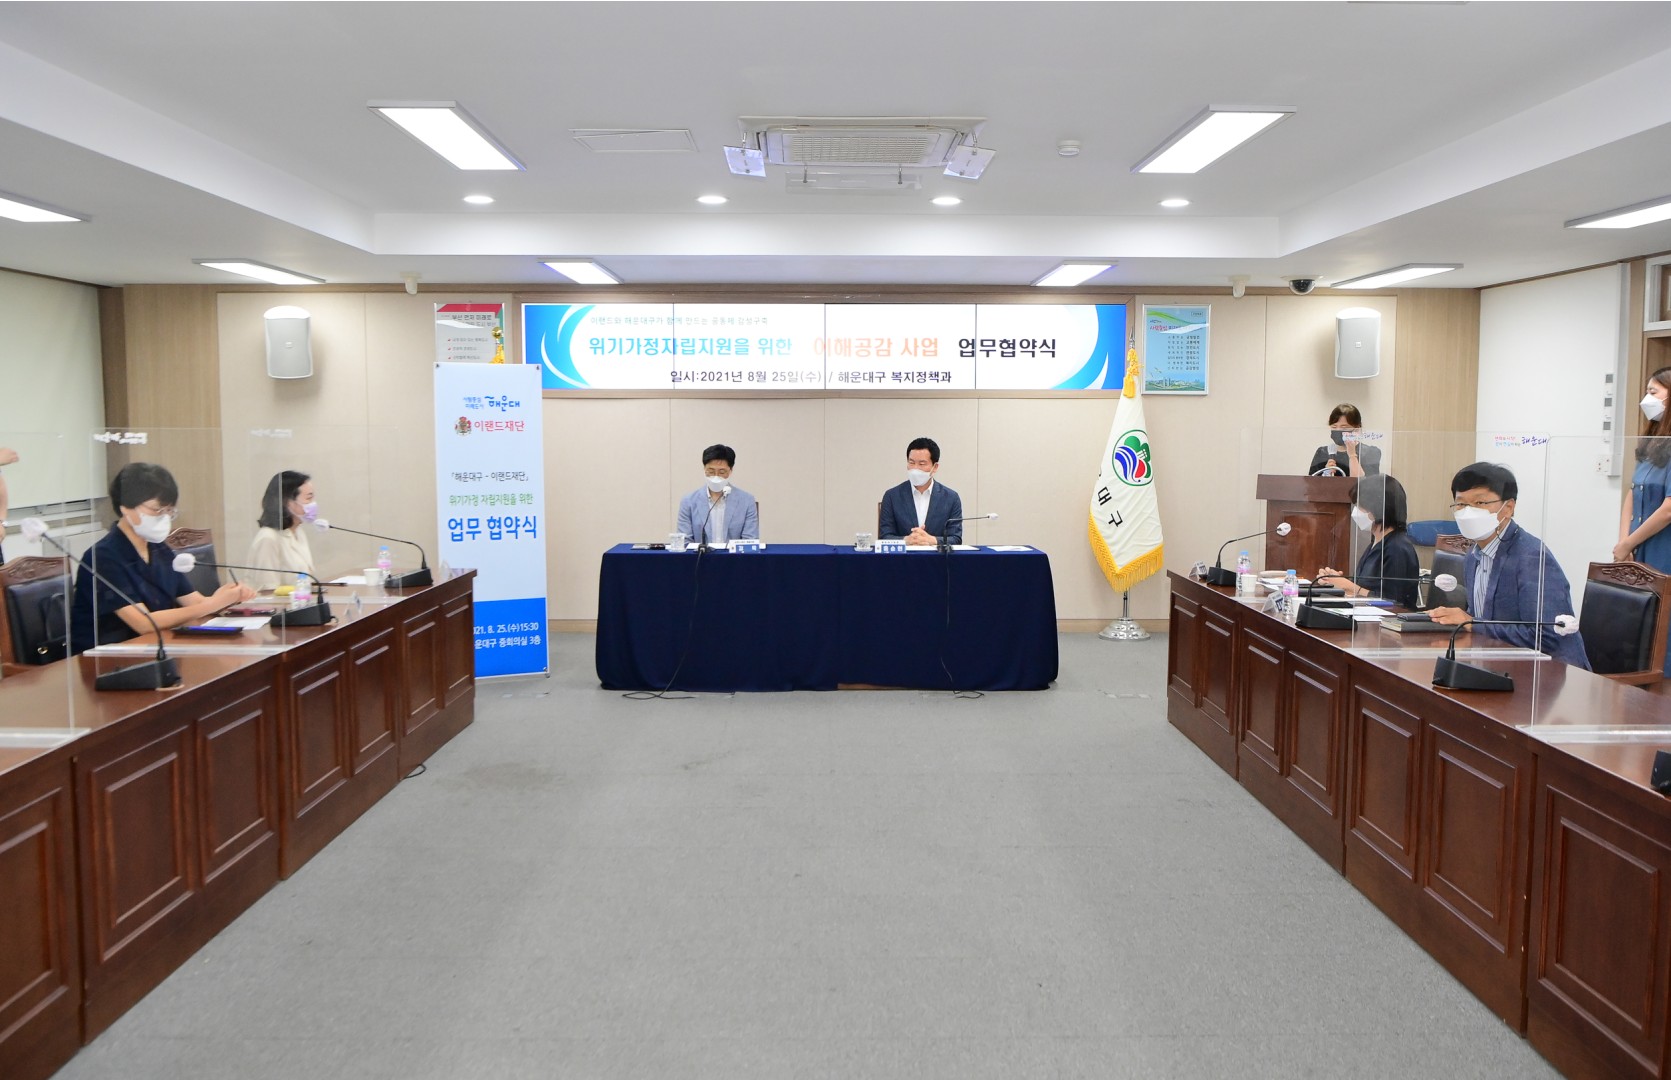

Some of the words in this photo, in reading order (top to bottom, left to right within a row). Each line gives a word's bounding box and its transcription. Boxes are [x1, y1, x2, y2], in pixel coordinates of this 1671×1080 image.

[624, 316, 663, 326] 해운대구가
[685, 316, 708, 326] 만드는
[589, 337, 750, 356] 위기가정자립지원을
[757, 337, 793, 356] 위한
[900, 337, 939, 357] 사업
[958, 338, 1056, 358] 업무협약식
[670, 370, 743, 383] 일시:2021년
[747, 370, 767, 383] 8월
[771, 370, 822, 383] 25일(수)
[838, 371, 887, 383] 해운대구
[890, 371, 952, 383] 복지정책과
[484, 395, 520, 412] 해운대
[474, 420, 525, 432] 이랜드재단
[449, 495, 479, 507] 위기가정
[481, 494, 517, 506] 자립지원을
[519, 493, 534, 505] 위한
[448, 518, 482, 542] 업무
[486, 516, 537, 540] 협약식
[473, 626, 487, 635] 21.
[474, 638, 497, 650] 운대구
